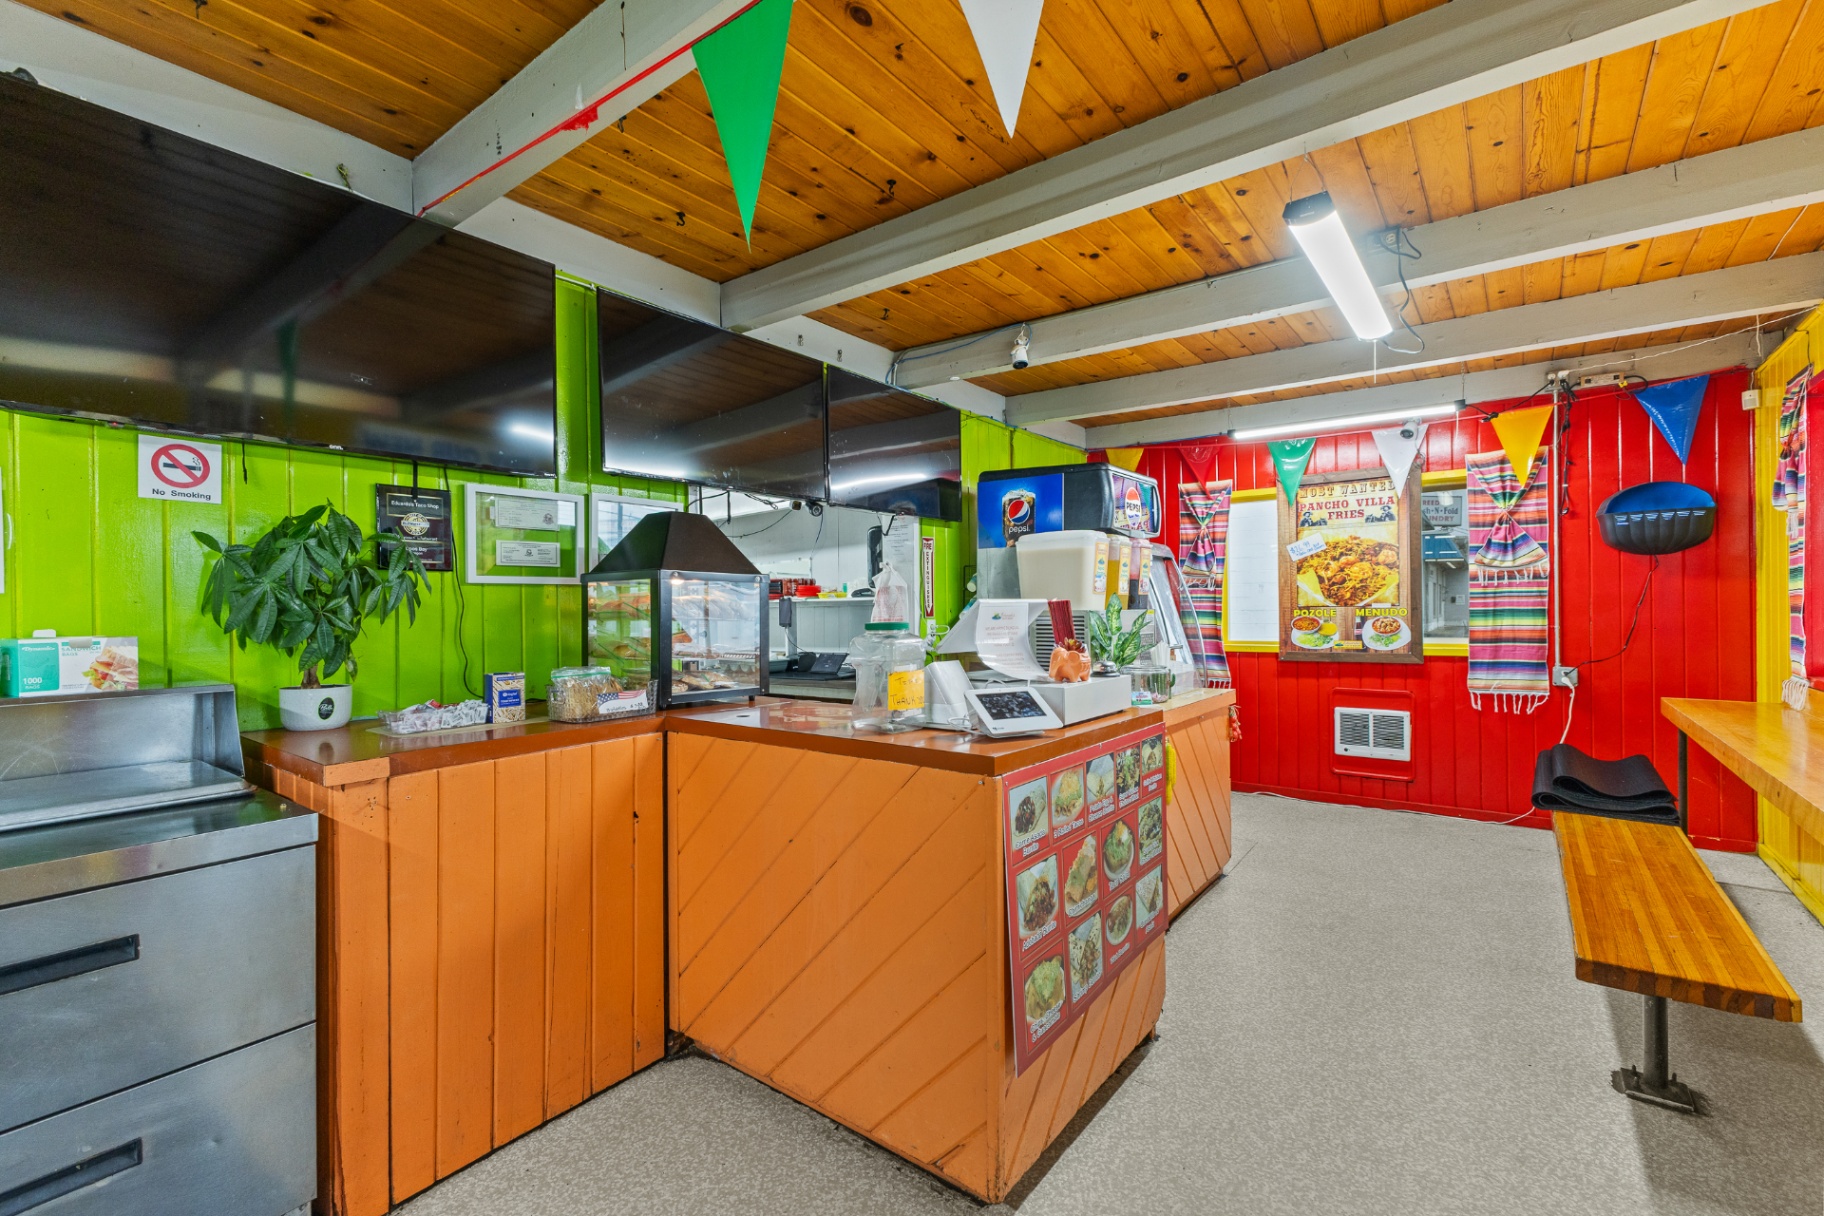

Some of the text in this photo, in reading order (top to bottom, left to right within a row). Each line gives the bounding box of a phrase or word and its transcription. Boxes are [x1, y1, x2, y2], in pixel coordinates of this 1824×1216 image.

[1300, 480, 1395, 498] MOST WANTED
[171, 490, 211, 500] Smoking
[1126, 502, 1140, 512] PEPSI
[1300, 496, 1395, 511] PANCHO VILLA
[1328, 509, 1365, 520] FRIES
[1294, 608, 1408, 617] POZOLE MENUDO
